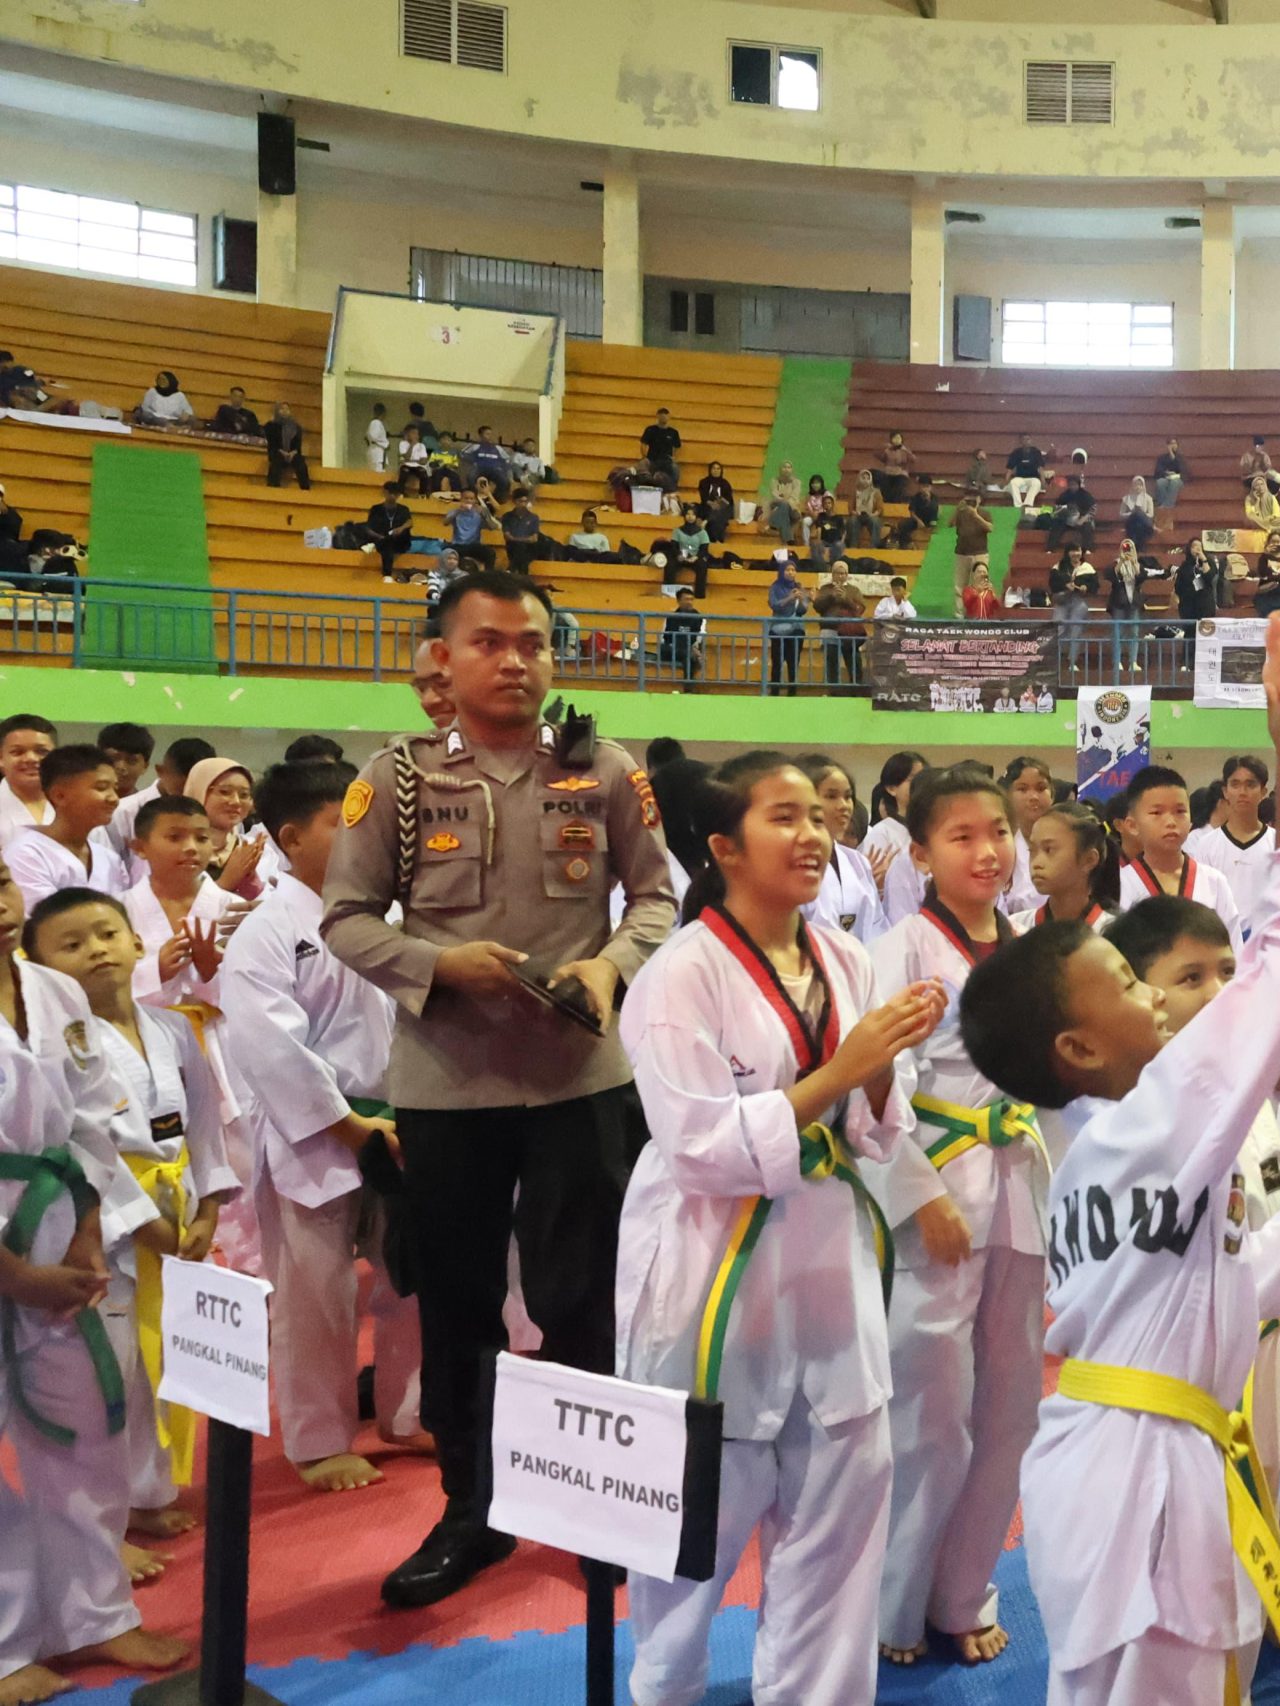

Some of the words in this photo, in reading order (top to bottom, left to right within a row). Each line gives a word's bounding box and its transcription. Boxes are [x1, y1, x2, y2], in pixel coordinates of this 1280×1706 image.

[901, 638, 959, 653] SELAMAT
[959, 639, 1041, 654] BERTANDING
[876, 690, 922, 703] RATC
[196, 1290, 242, 1328] RTTC
[172, 1334, 223, 1366] PANGKAL
[225, 1352, 267, 1381] PINANG
[554, 1398, 635, 1447] TTTC
[510, 1450, 596, 1492] PANGKAL
[602, 1476, 681, 1513] PINANG
